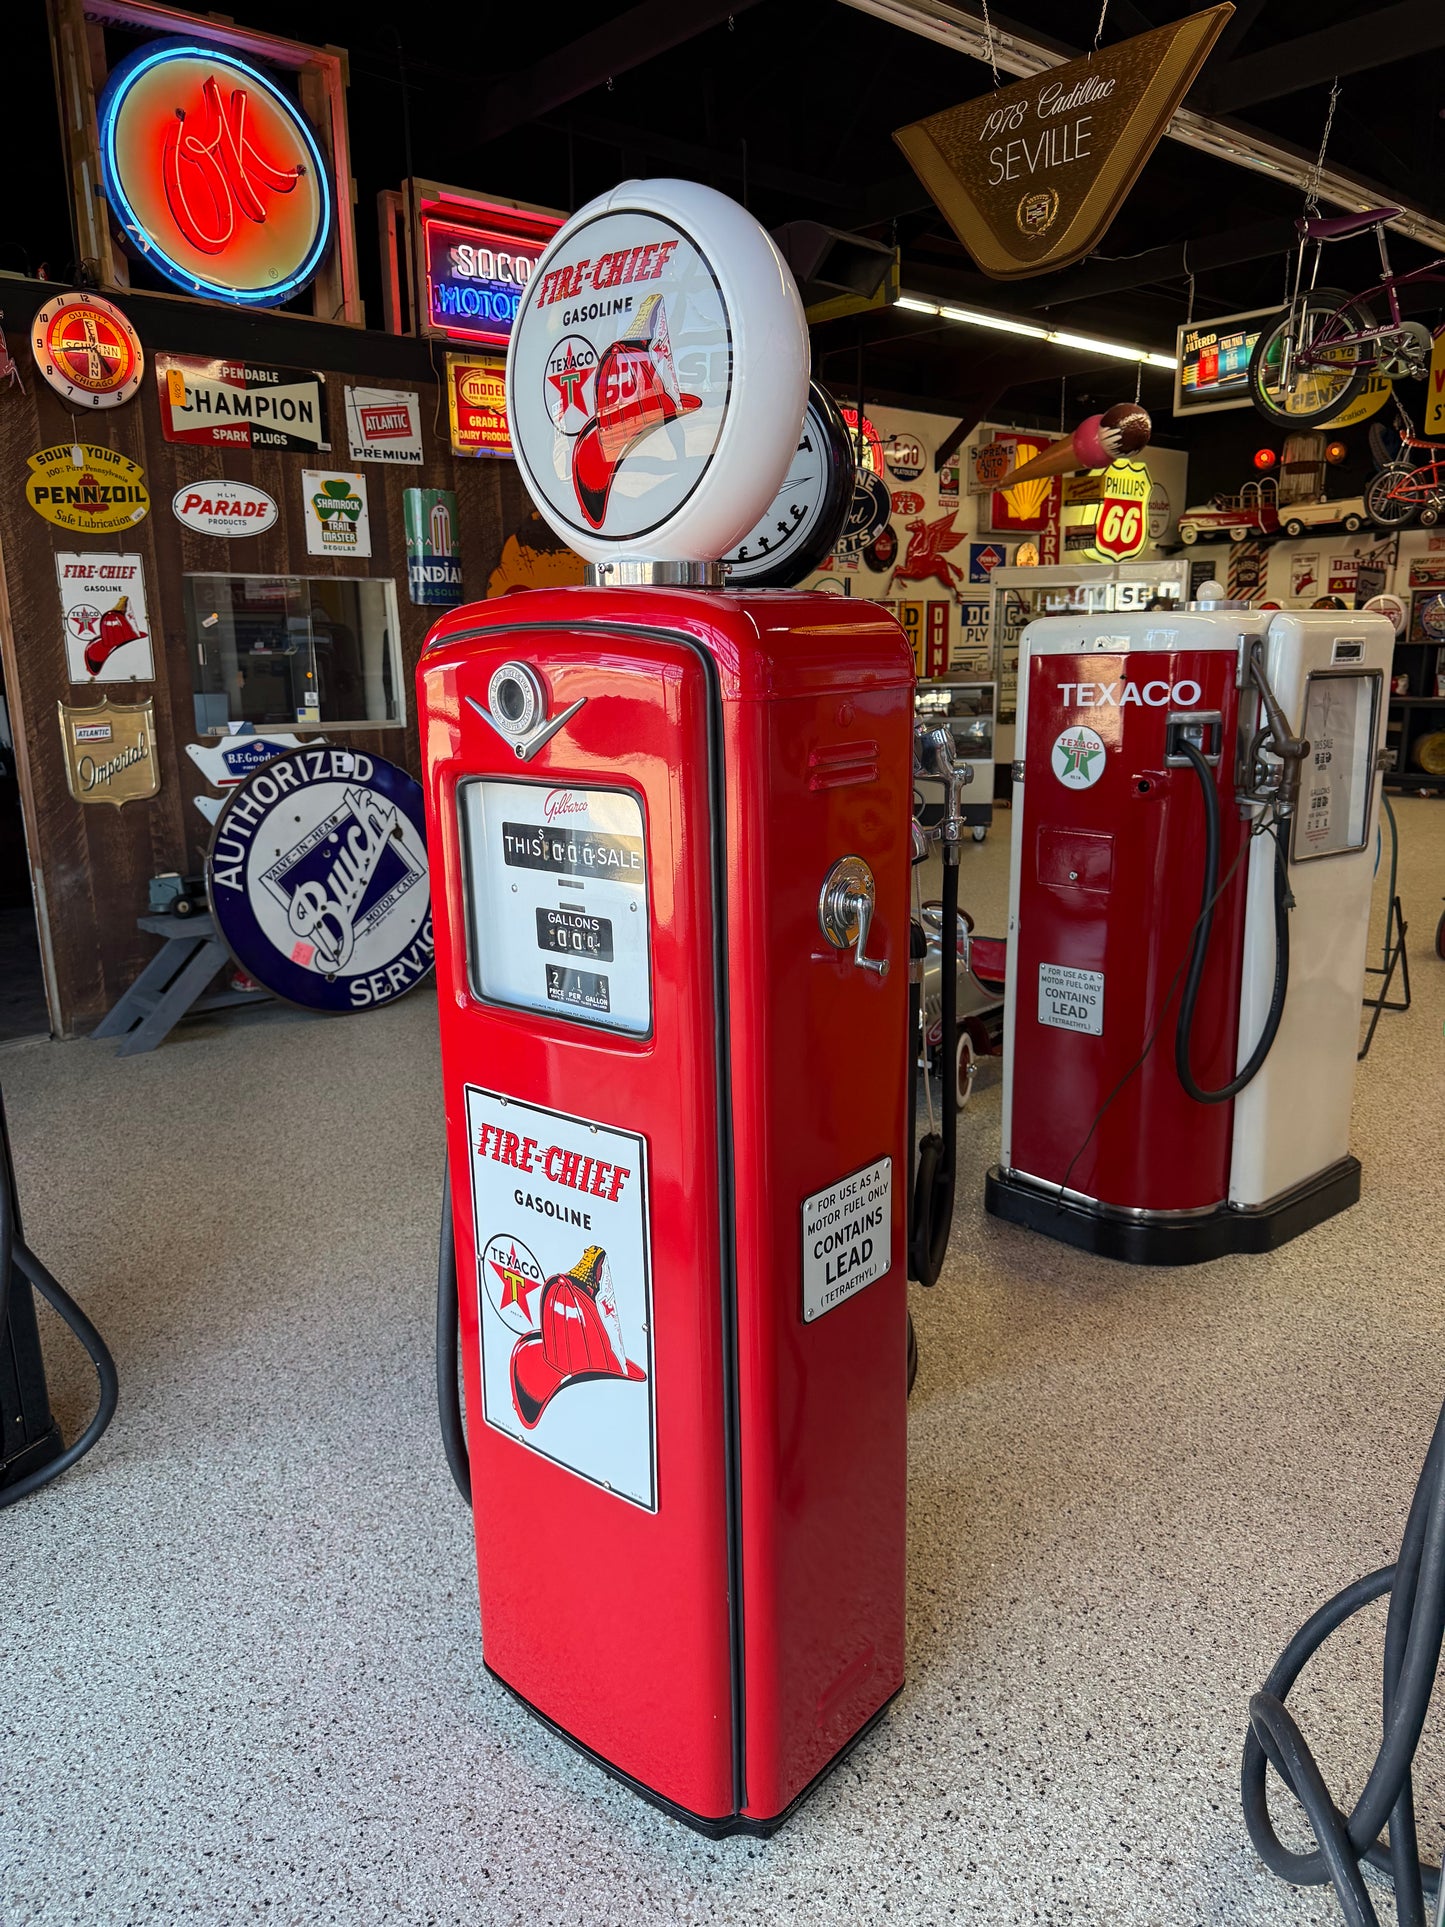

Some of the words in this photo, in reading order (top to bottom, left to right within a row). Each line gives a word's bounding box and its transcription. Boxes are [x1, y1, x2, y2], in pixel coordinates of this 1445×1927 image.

[978, 100, 1029, 142] 1978
[1037, 75, 1116, 120] Cadillac
[988, 115, 1093, 187] SEVILLE
[453, 244, 538, 287] SOCO
[536, 240, 679, 309] FIRE-CHIEF
[56, 298, 64, 306] 11
[80, 294, 90, 303] 12
[40, 314, 49, 322] 10
[68, 311, 108, 325] QUALITY
[563, 297, 633, 326] GASOLINE
[127, 325, 133, 335] 2
[1186, 331, 1199, 343] THE
[37, 339, 43, 348] 9
[1185, 334, 1217, 353] FILTERED
[137, 351, 142, 360] 3
[551, 351, 594, 373] TEXACO
[46, 366, 53, 375] 8
[74, 374, 114, 388] CHICAGO
[132, 376, 138, 384] 4
[67, 386, 74, 395] 7
[117, 392, 123, 401] 5
[93, 396, 99, 405] 6
[181, 388, 314, 424] CHAMPION
[365, 413, 408, 432] ATLANTIC
[469, 415, 498, 428] GRADE
[500, 419, 506, 429] A
[212, 428, 249, 443] SPARK
[252, 431, 288, 446] PLUGS
[459, 430, 481, 440] DAIRY
[36, 447, 74, 466] SOUN
[86, 446, 121, 465] YOUR
[125, 461, 136, 473] Z
[353, 447, 421, 462] PREMIUM
[971, 445, 1015, 460] SUPREME
[981, 457, 1003, 468] AUTO
[66, 464, 83, 473] Pure
[85, 464, 129, 483] Pennsylvania
[983, 467, 999, 479] OIL
[33, 485, 147, 505] PENNZOIL
[1106, 477, 1146, 497] PHILLIPS
[180, 493, 269, 519] PARADE
[317, 497, 361, 512] SHAMROCK
[897, 501, 916, 514] X3
[54, 509, 76, 525] Safe
[78, 515, 131, 529] Lubrication
[208, 518, 248, 527] PRODUCTS
[328, 521, 352, 532] TRAIL
[1102, 505, 1141, 544] 66
[322, 532, 357, 544] MASTER
[323, 544, 357, 552] REGULAR
[63, 564, 137, 579] FIRE-CHIEF
[1057, 680, 1202, 707] TEXACO
[78, 728, 110, 737] ATLANTIC
[1061, 738, 1100, 750] TEXACO
[77, 732, 148, 792] Imperial
[544, 788, 588, 824] Gilbarco
[214, 750, 374, 892] AUTHORIZED
[504, 835, 542, 857] THIS
[597, 847, 641, 869] SALE
[366, 894, 396, 924] MOTOR
[397, 870, 420, 895] CARS
[548, 912, 600, 931] GALLONS
[349, 914, 434, 1007] SERVIC
[1048, 968, 1061, 976] FOR
[1063, 971, 1076, 979] USE
[1078, 973, 1088, 981] AS
[1041, 975, 1064, 985] MOTOR
[1066, 980, 1083, 989] FUEL
[1084, 983, 1102, 992] ONLY
[549, 988, 564, 997] PRICE
[568, 991, 581, 1000] PER
[585, 995, 608, 1006] GALLON
[1045, 988, 1096, 1005] CONTAINS
[1052, 1002, 1088, 1019] LEAD
[1049, 1016, 1091, 1030] (TETRAETHYL)
[474, 1122, 631, 1203] FIRE-CHIEF
[817, 1193, 836, 1213] FOR
[839, 1181, 857, 1201] USE
[859, 1174, 871, 1190] AS
[873, 1170, 881, 1182] A
[514, 1189, 592, 1231] GASOLINE
[807, 1209, 841, 1237] MOTOR
[844, 1200, 866, 1217] FUEL
[867, 1181, 889, 1203] ONLY
[813, 1206, 883, 1260] CONTAINS
[491, 1246, 540, 1279] TEXACO
[825, 1238, 874, 1286] LEAD
[820, 1263, 878, 1308] (TETRAETHYL)
